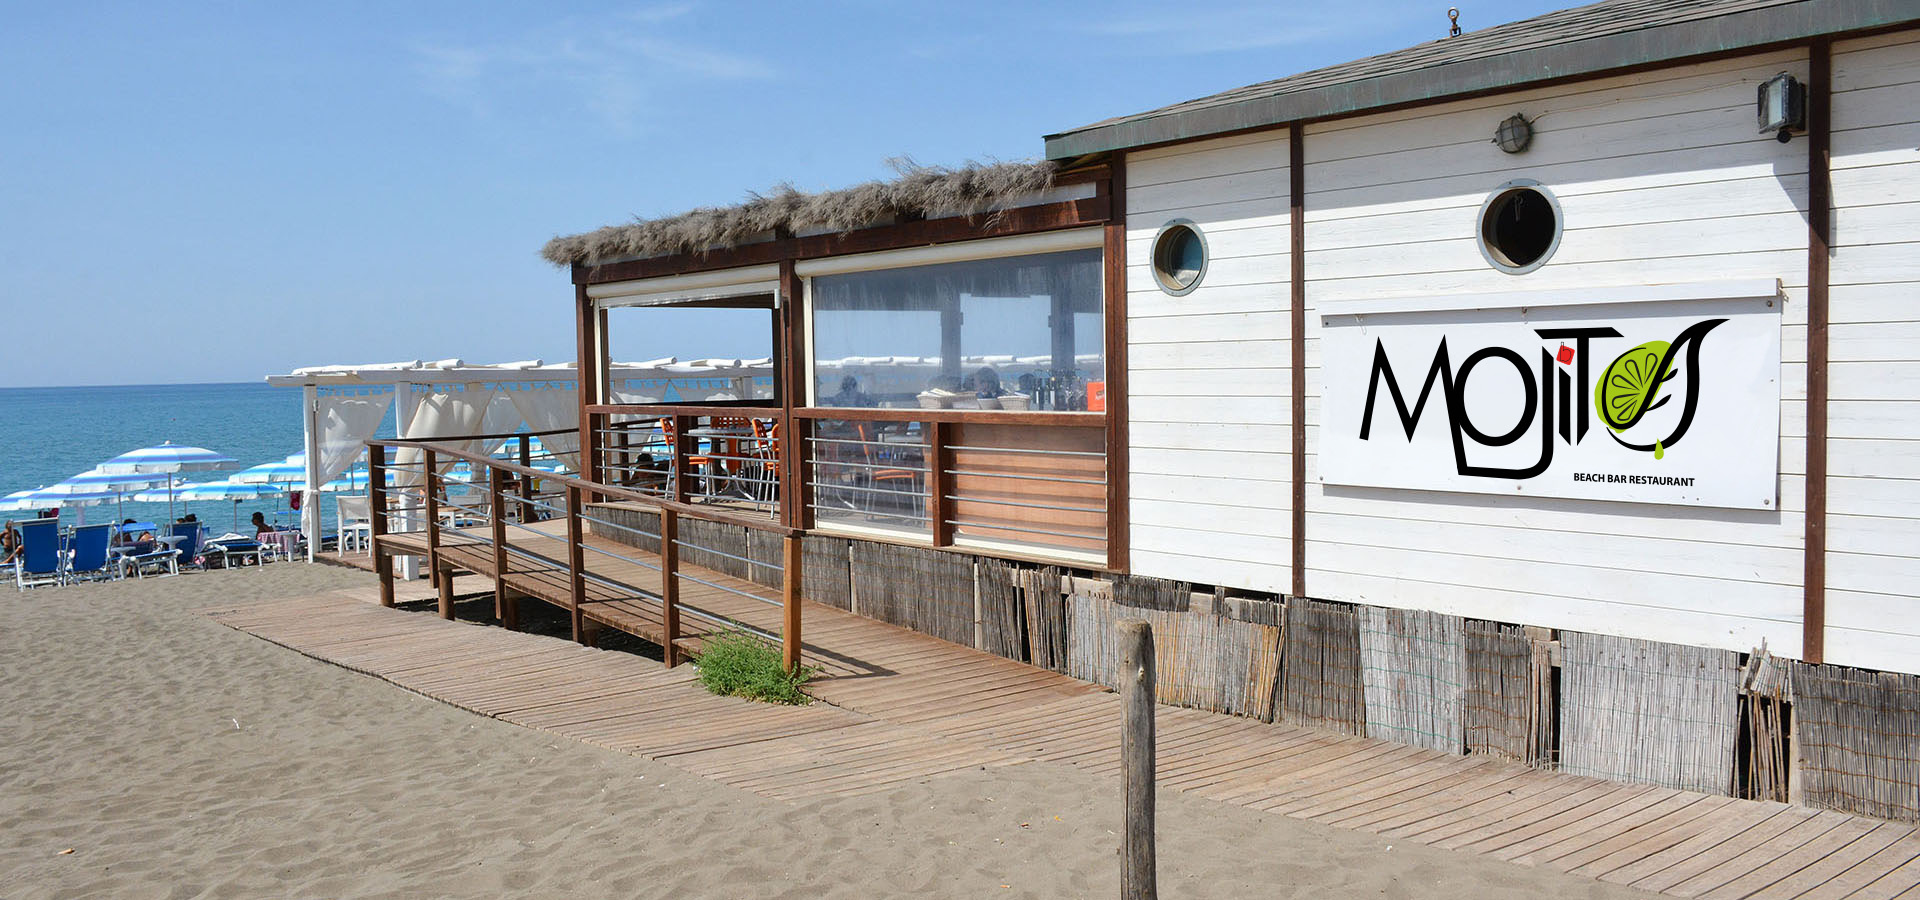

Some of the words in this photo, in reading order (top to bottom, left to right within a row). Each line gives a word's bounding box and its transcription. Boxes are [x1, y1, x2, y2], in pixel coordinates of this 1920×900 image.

[1574, 473, 1604, 482] BEACH
[1608, 475, 1626, 483] BAR
[1629, 475, 1695, 486] RESTAURANT
